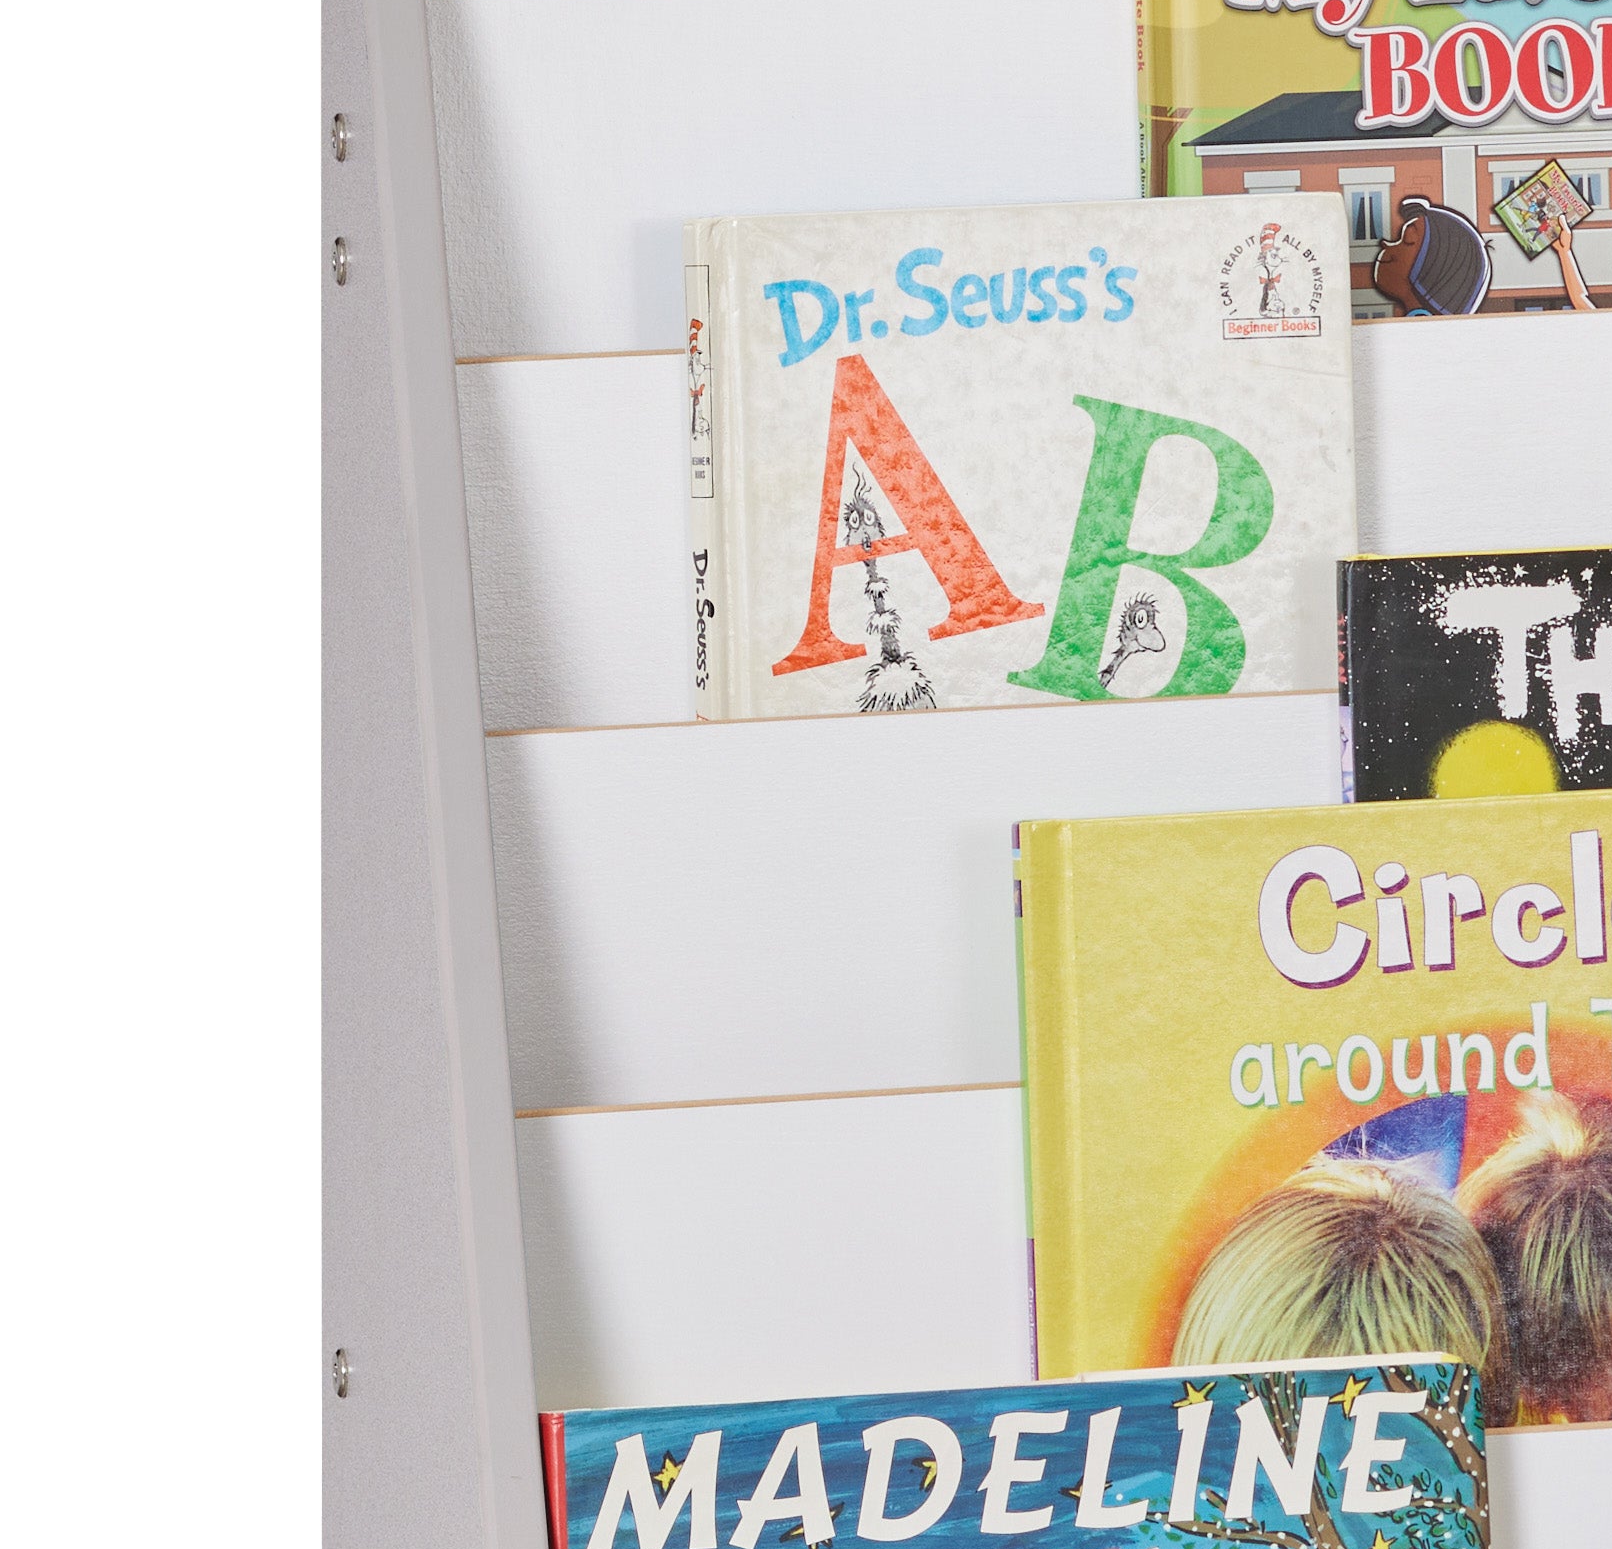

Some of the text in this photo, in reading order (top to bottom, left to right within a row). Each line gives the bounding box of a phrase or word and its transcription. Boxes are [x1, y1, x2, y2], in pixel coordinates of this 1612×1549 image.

[1245, 235, 1255, 247] IT
[1282, 234, 1301, 250] ALL
[1221, 245, 1243, 275] READ
[1303, 249, 1317, 263] BY
[1220, 282, 1232, 306] CAN
[1308, 267, 1323, 313] MYSELF
[763, 246, 1138, 367] Dr. Seuss's
[1228, 320, 1317, 335] Beginner Books
[693, 549, 714, 690] Dr. Seuss's
[1230, 1001, 1553, 1108] around
